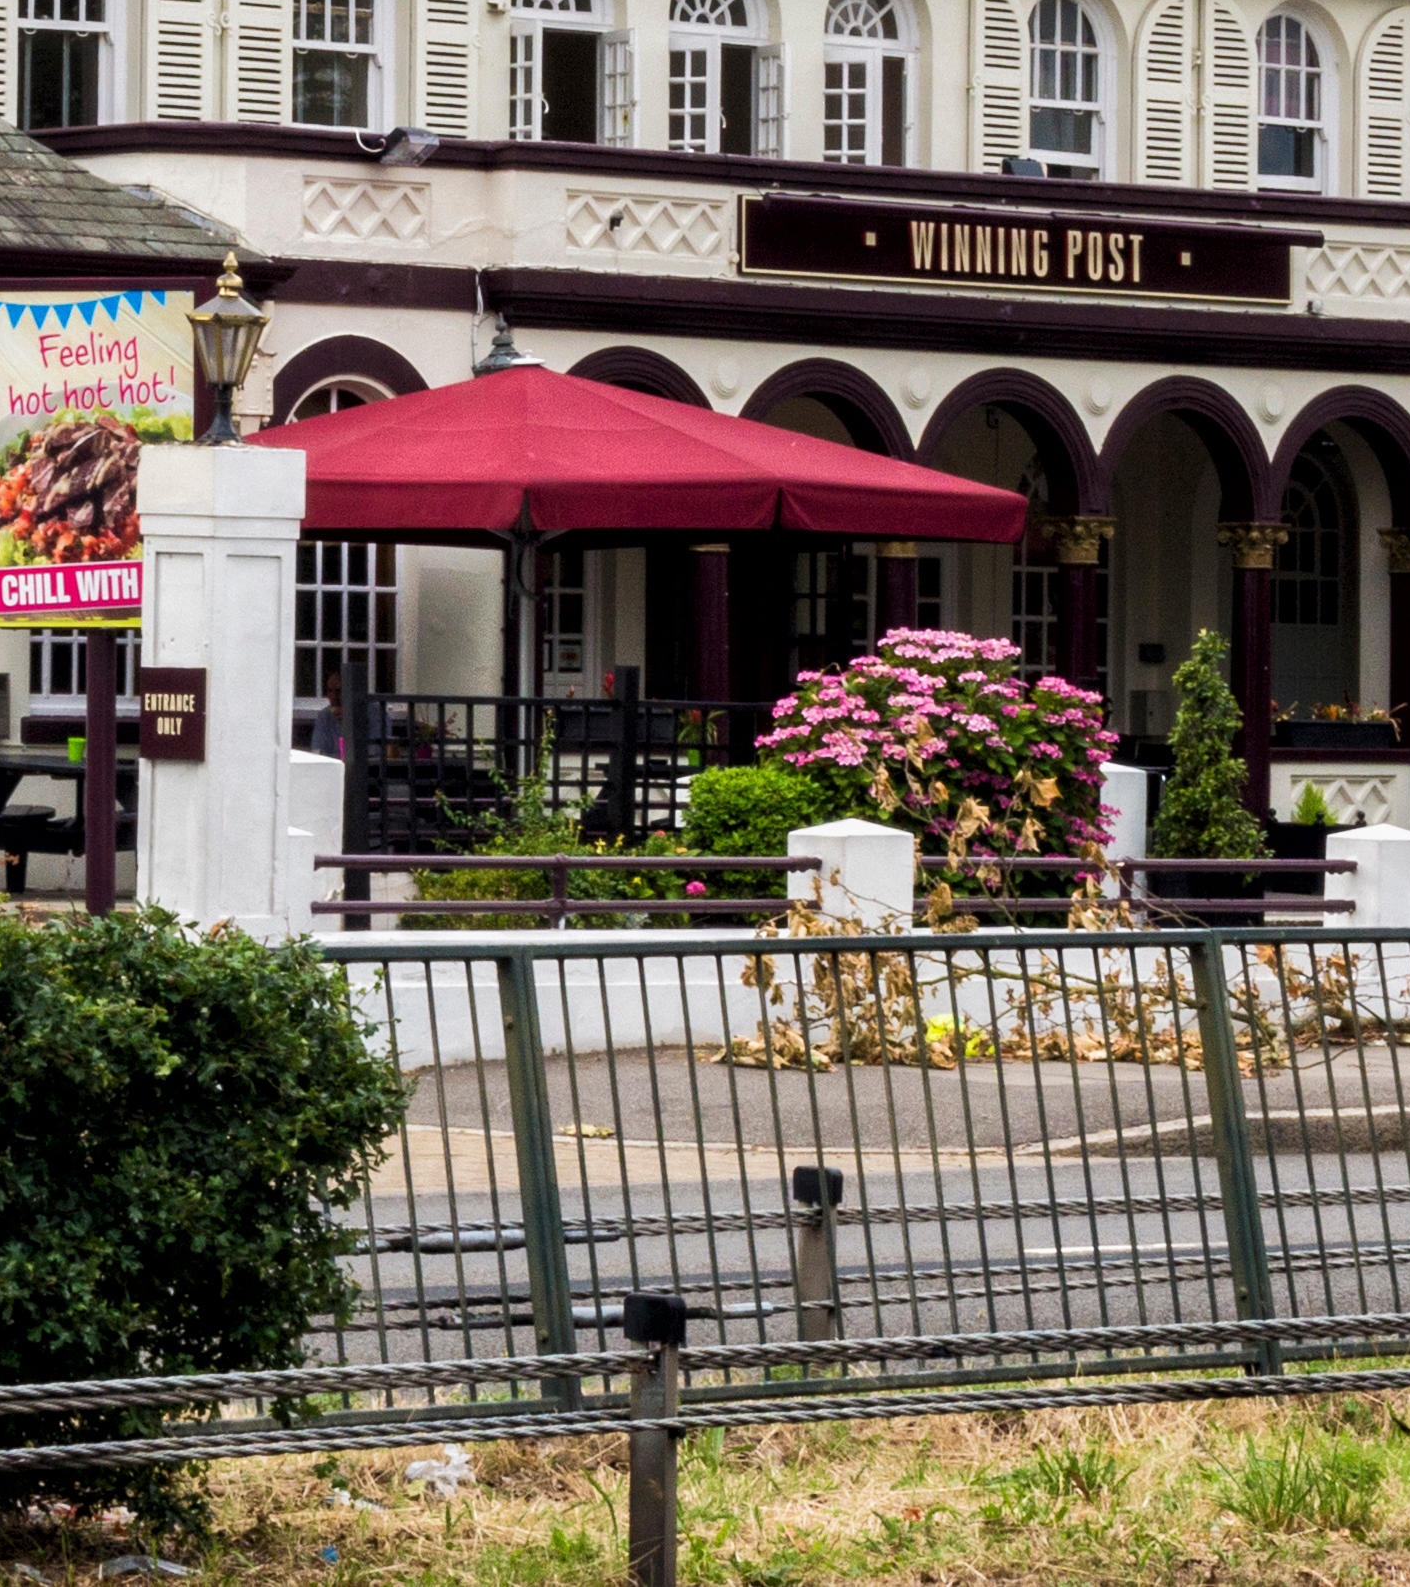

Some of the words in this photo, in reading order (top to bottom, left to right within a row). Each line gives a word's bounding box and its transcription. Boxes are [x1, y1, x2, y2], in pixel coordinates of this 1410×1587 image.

[910, 220, 1048, 278] WINNING
[1066, 229, 1143, 282] POST
[39, 331, 139, 379] Feeling
[8, 383, 58, 415] hot
[63, 377, 113, 410] hot
[119, 365, 176, 406] hot!
[1, 572, 71, 606] CHILL
[75, 567, 139, 602] WITH
[144, 693, 195, 712] ENTRANCE
[157, 716, 182, 735] ONLY
